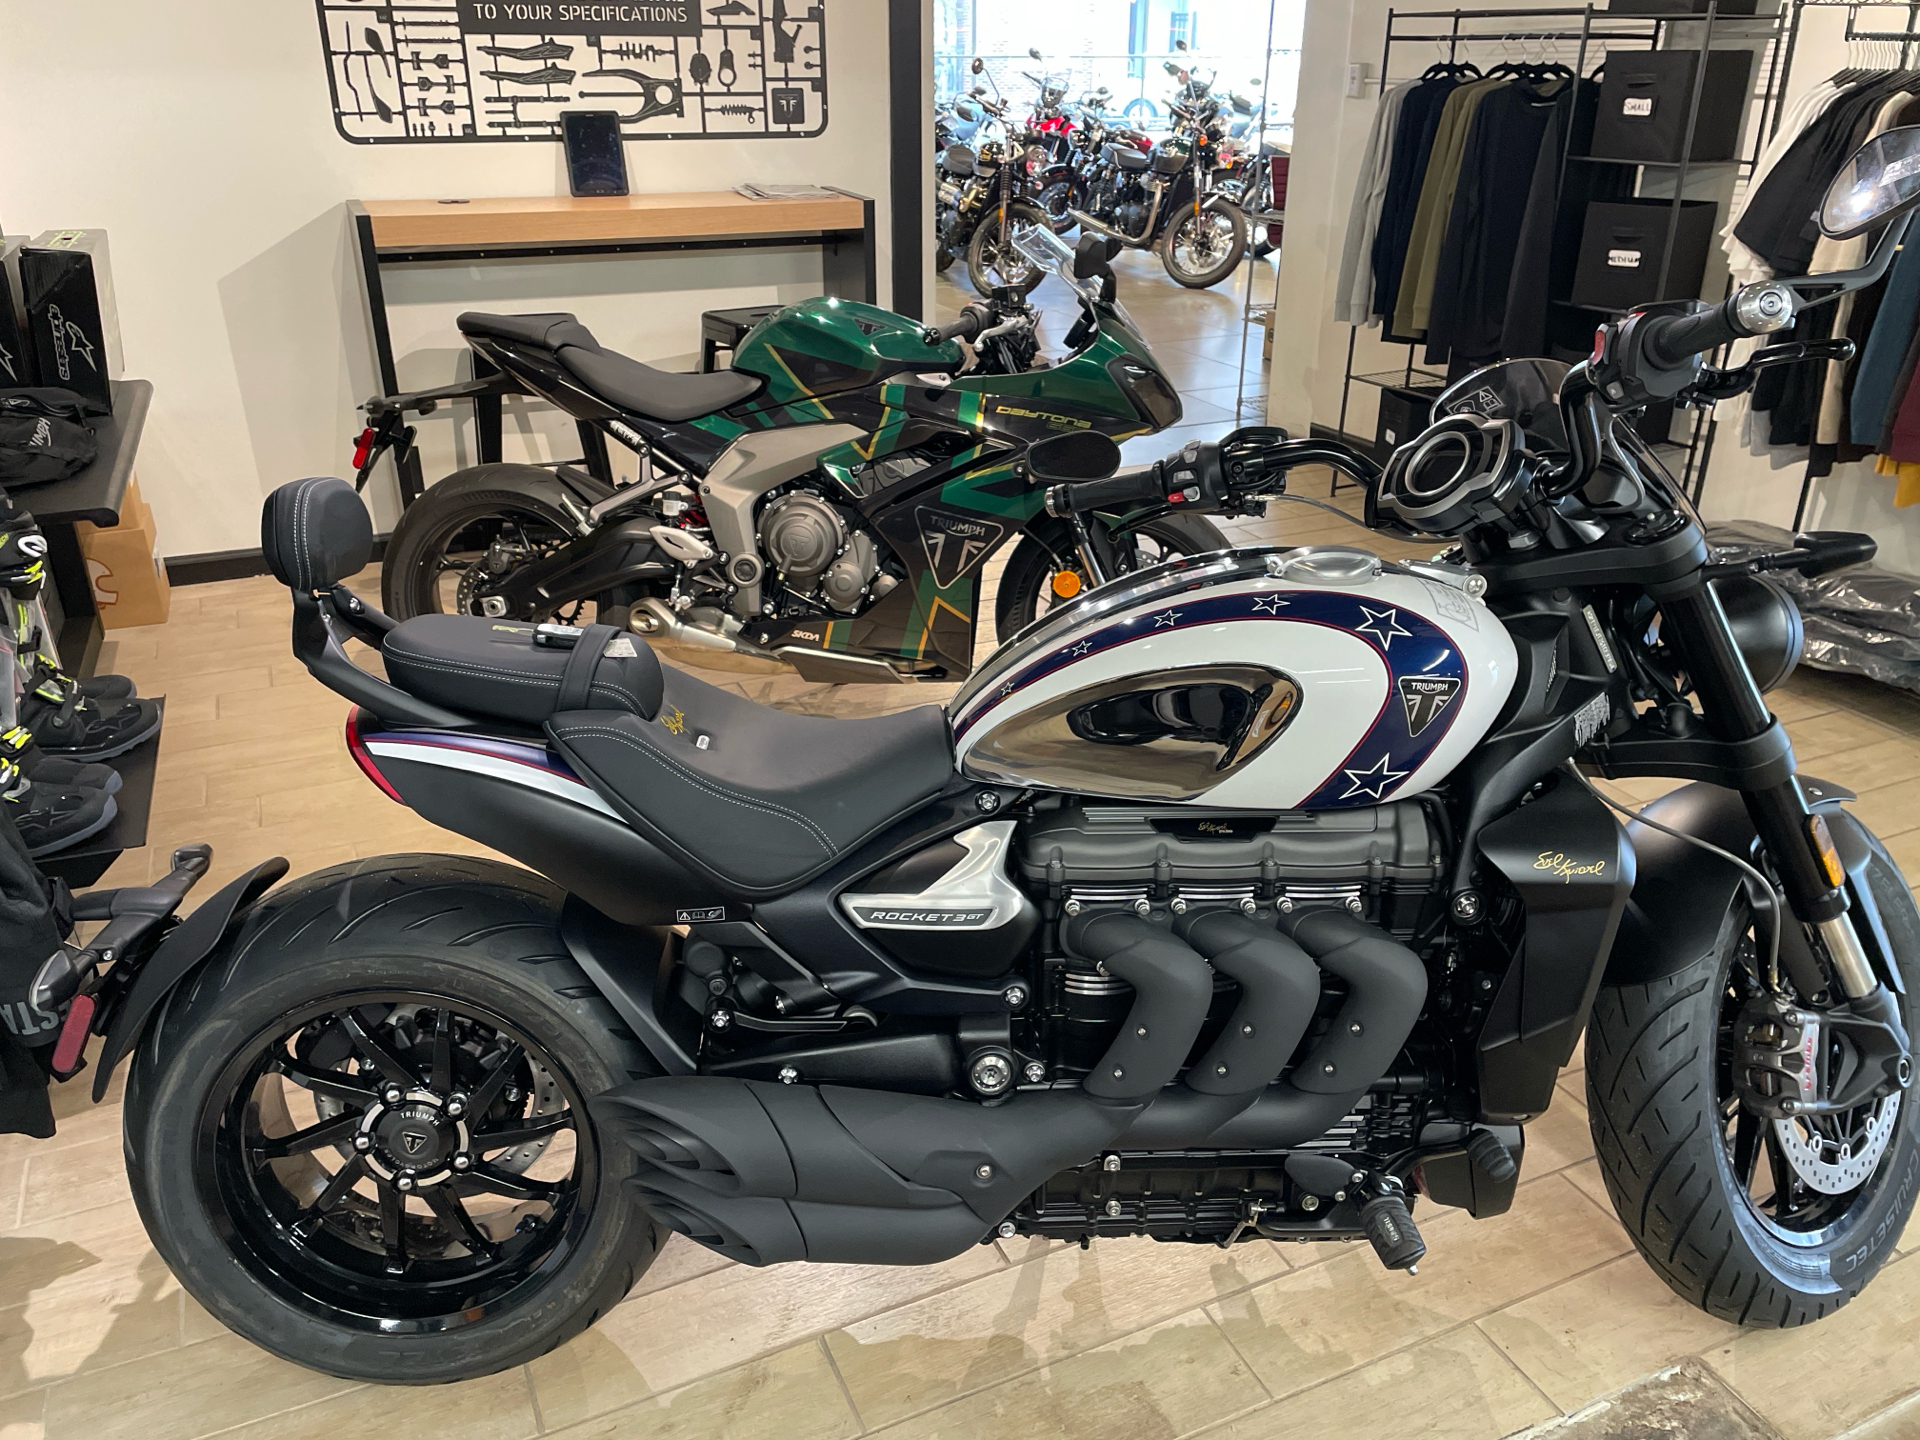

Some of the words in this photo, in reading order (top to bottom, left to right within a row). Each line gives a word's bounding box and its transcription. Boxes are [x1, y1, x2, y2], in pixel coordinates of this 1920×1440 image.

[473, 3, 497, 19] TO
[503, 4, 553, 20] YOUR
[557, 5, 688, 23] SPECIFICATIONS
[930, 515, 986, 537] TRIUMPH
[791, 629, 820, 642] SKDA
[1411, 682, 1448, 694] TRIUMPH
[870, 911, 953, 922] ROCKET
[400, 1111, 440, 1127] TRIUMPH
[1846, 1148, 1919, 1273] CRUISETEC
